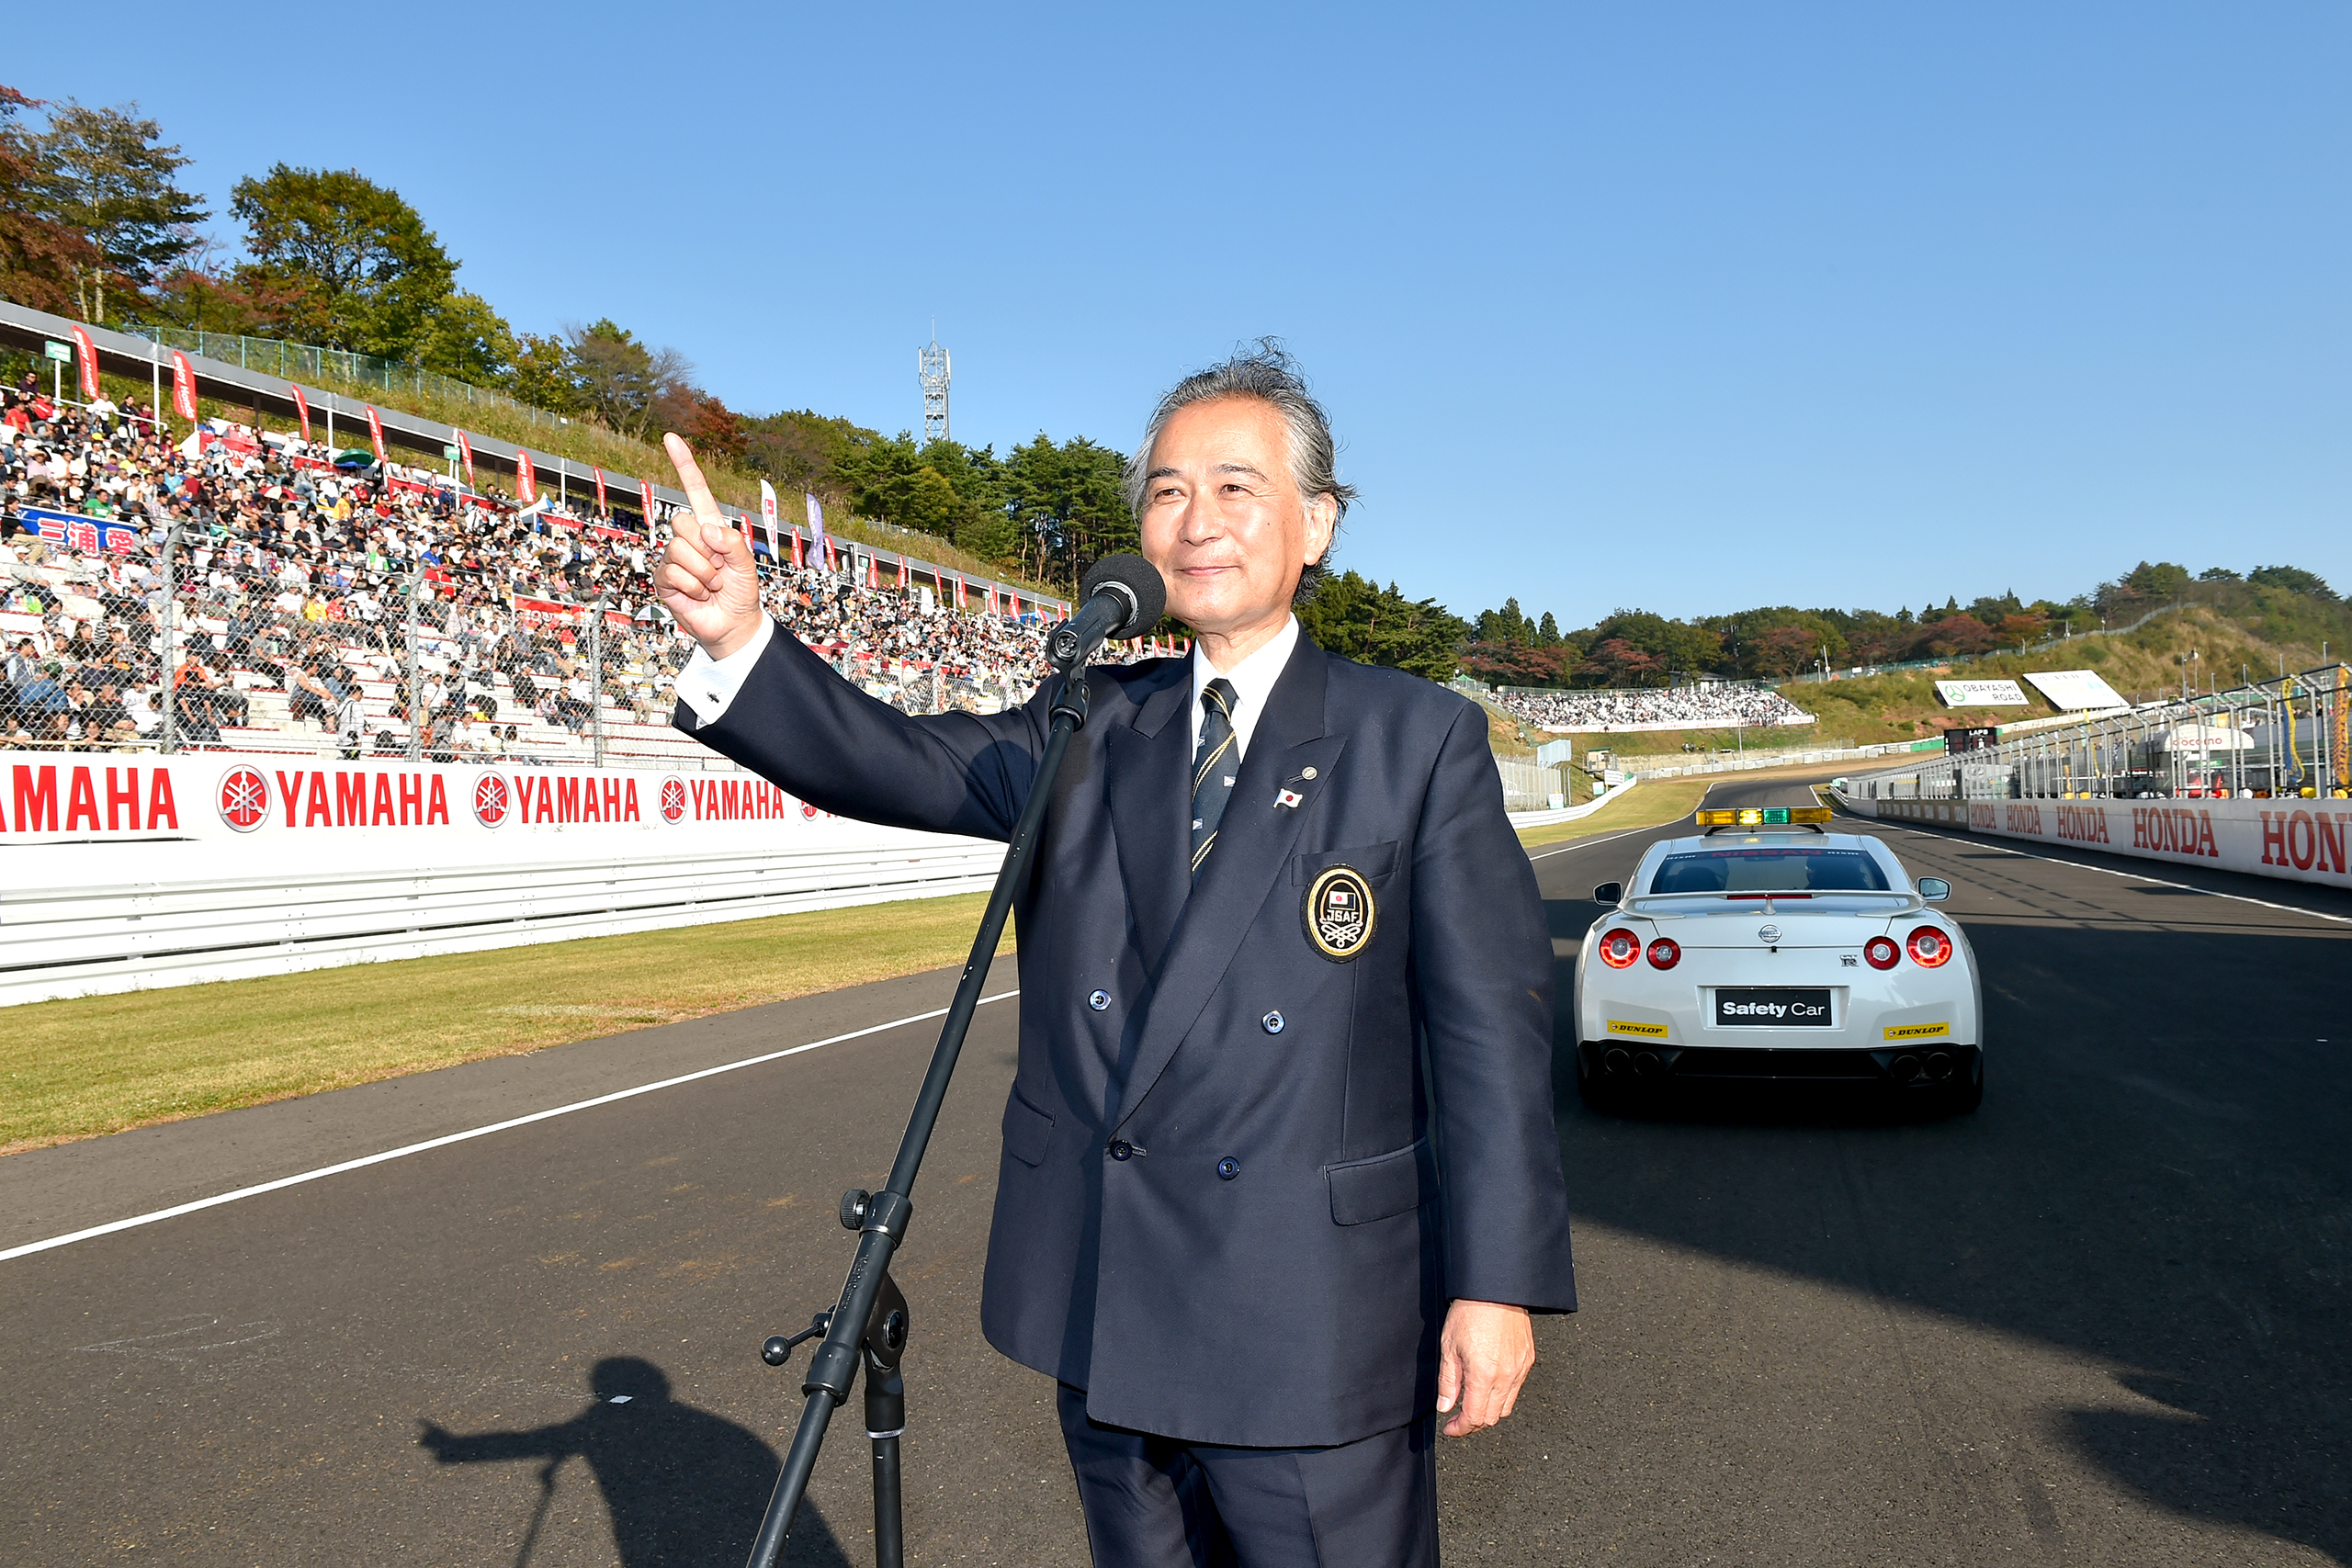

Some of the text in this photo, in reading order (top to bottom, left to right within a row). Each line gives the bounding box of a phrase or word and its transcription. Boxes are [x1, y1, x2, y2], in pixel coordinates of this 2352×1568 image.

[74, 330, 96, 399] Enjoy Honda
[174, 355, 187, 387] Enjoy
[179, 383, 195, 419] Honda
[1962, 683, 2018, 693] OBAYASHI
[1992, 693, 2023, 702] ROAD
[1968, 728, 1989, 736] LAPS
[0, 764, 179, 832] MAHA
[276, 770, 449, 828] YAMAHA
[513, 775, 640, 824] YAMAHA
[689, 778, 785, 821] YAMAHA
[1971, 804, 1997, 829] HONDA
[2007, 804, 2042, 835] HONDA
[2056, 805, 2110, 844] HONDA
[2132, 807, 2219, 858] HONDA
[2259, 808, 2352, 874] HON
[1711, 849, 1823, 858] NISSAN
[1326, 908, 1360, 924] JSAF
[1723, 1001, 1826, 1019] Safety Car
[1619, 1024, 1663, 1034] DUNLOP
[1897, 1026, 1944, 1036] DUNLOP
